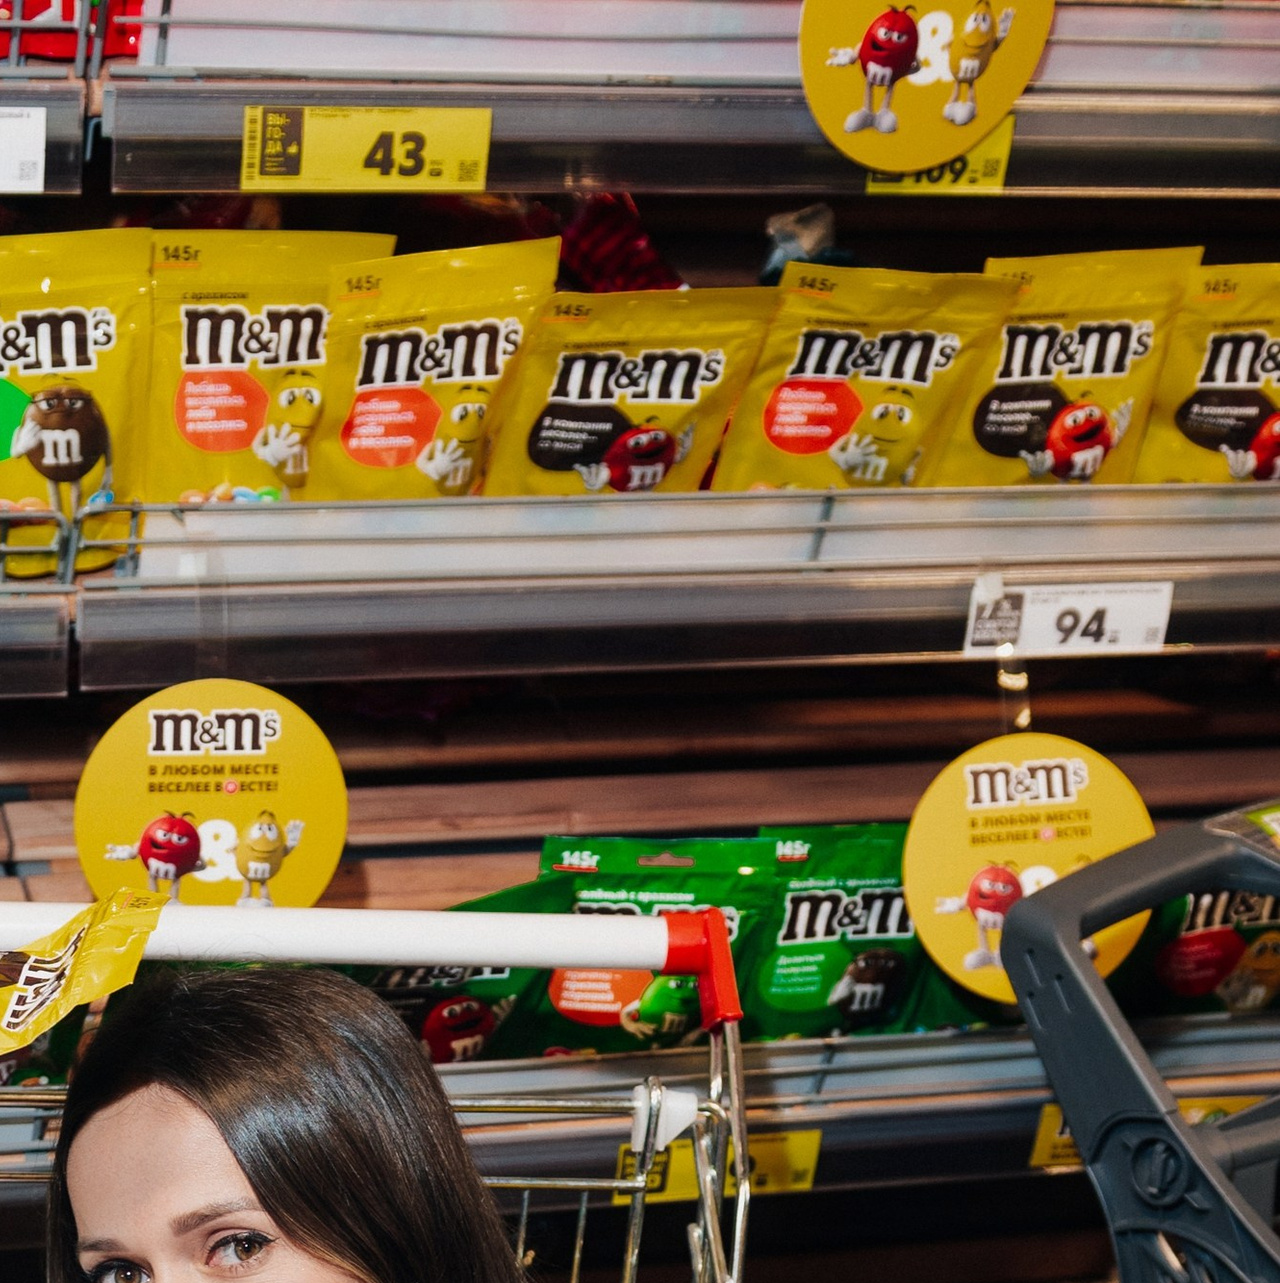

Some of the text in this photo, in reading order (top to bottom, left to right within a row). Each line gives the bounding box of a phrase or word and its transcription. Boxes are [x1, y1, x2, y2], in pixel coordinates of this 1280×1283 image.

[364, 131, 426, 176] 43
[163, 246, 201, 261] 145г
[1056, 607, 1106, 644] 94
[152, 712, 278, 752] m&m's
[149, 763, 279, 776] В ЛЮБОМ МЕСТЕ
[149, 780, 278, 795] ВЕСЕЛЕЕ ВЕСТЕ!
